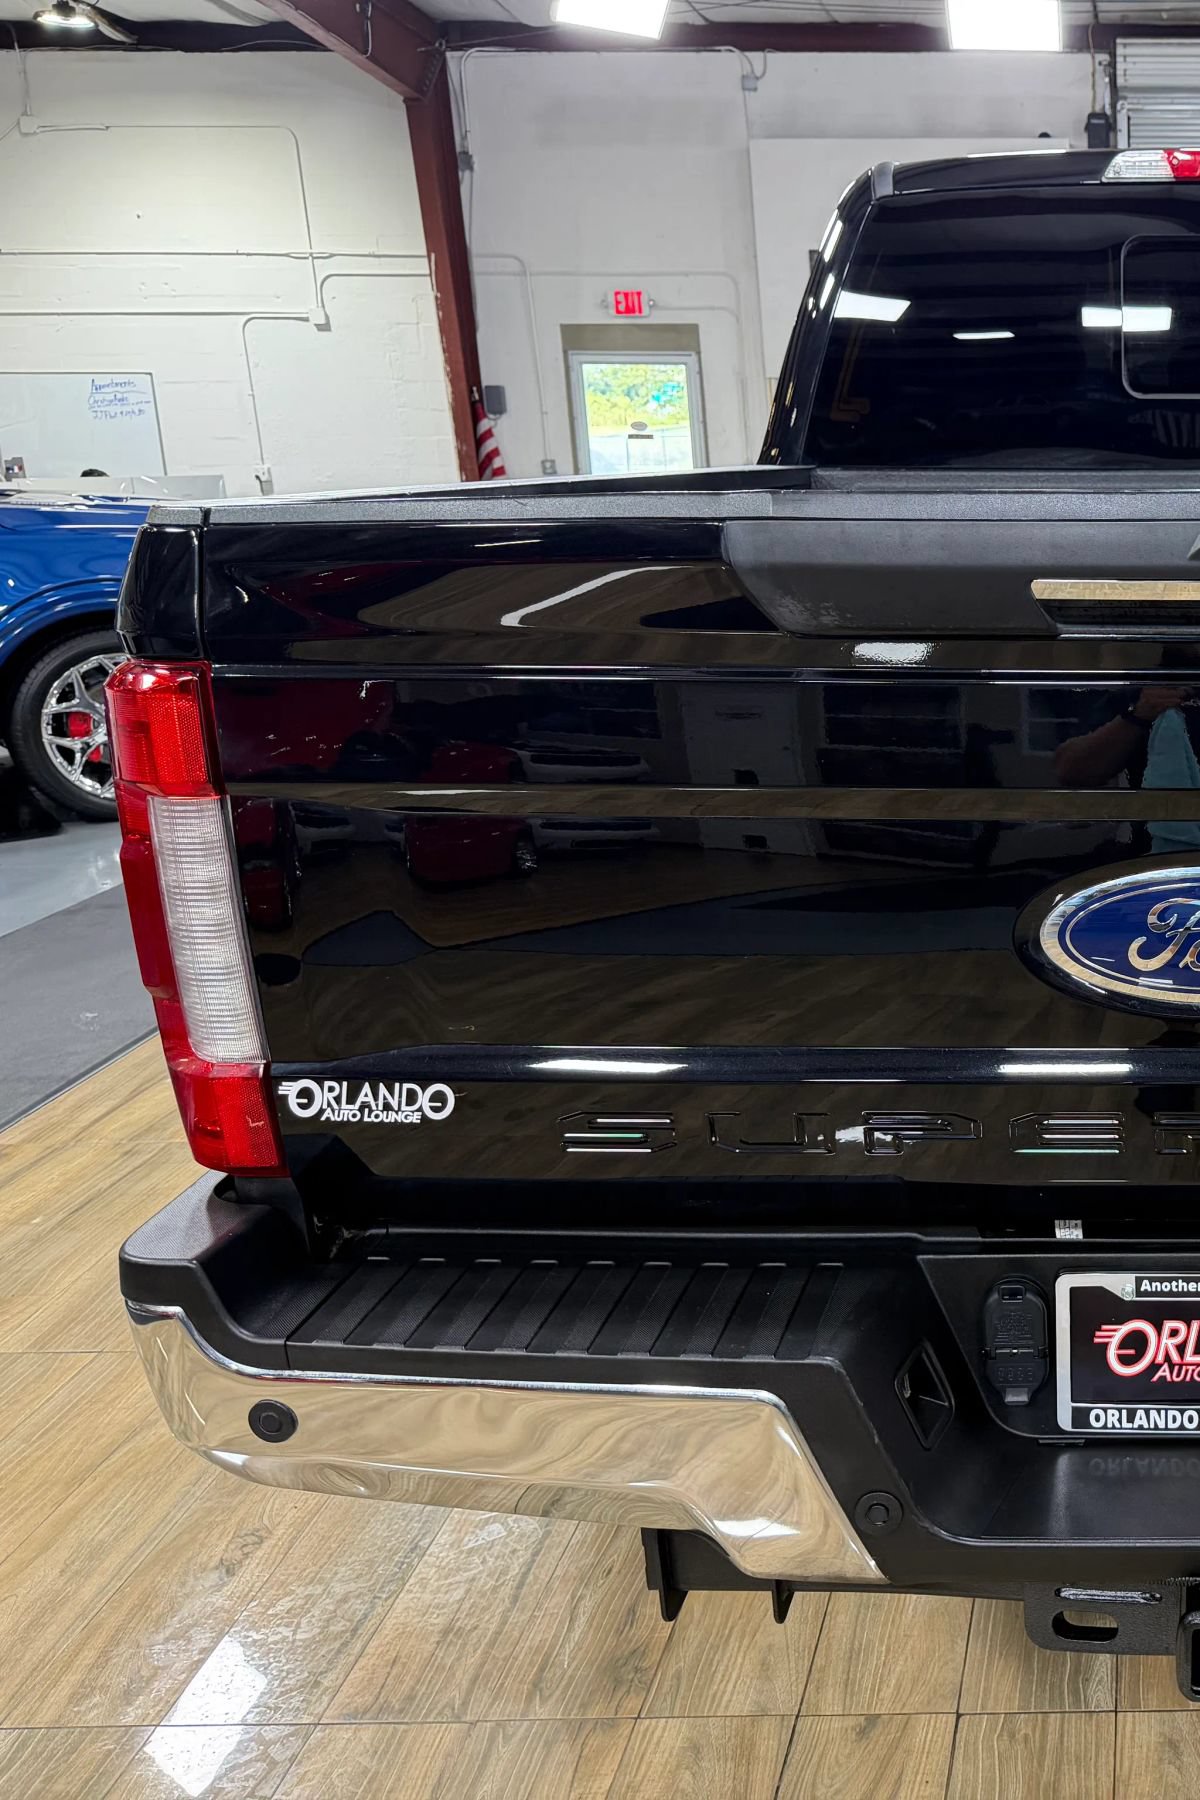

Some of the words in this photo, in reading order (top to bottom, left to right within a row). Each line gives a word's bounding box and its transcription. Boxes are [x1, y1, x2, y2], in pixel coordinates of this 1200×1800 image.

[613, 290, 643, 315] EXIT
[278, 1079, 456, 1120] ORLANDO
[320, 1107, 361, 1122] AUTO
[364, 1109, 423, 1123] LOUNGE
[1089, 1408, 1199, 1430] ORLANDO
